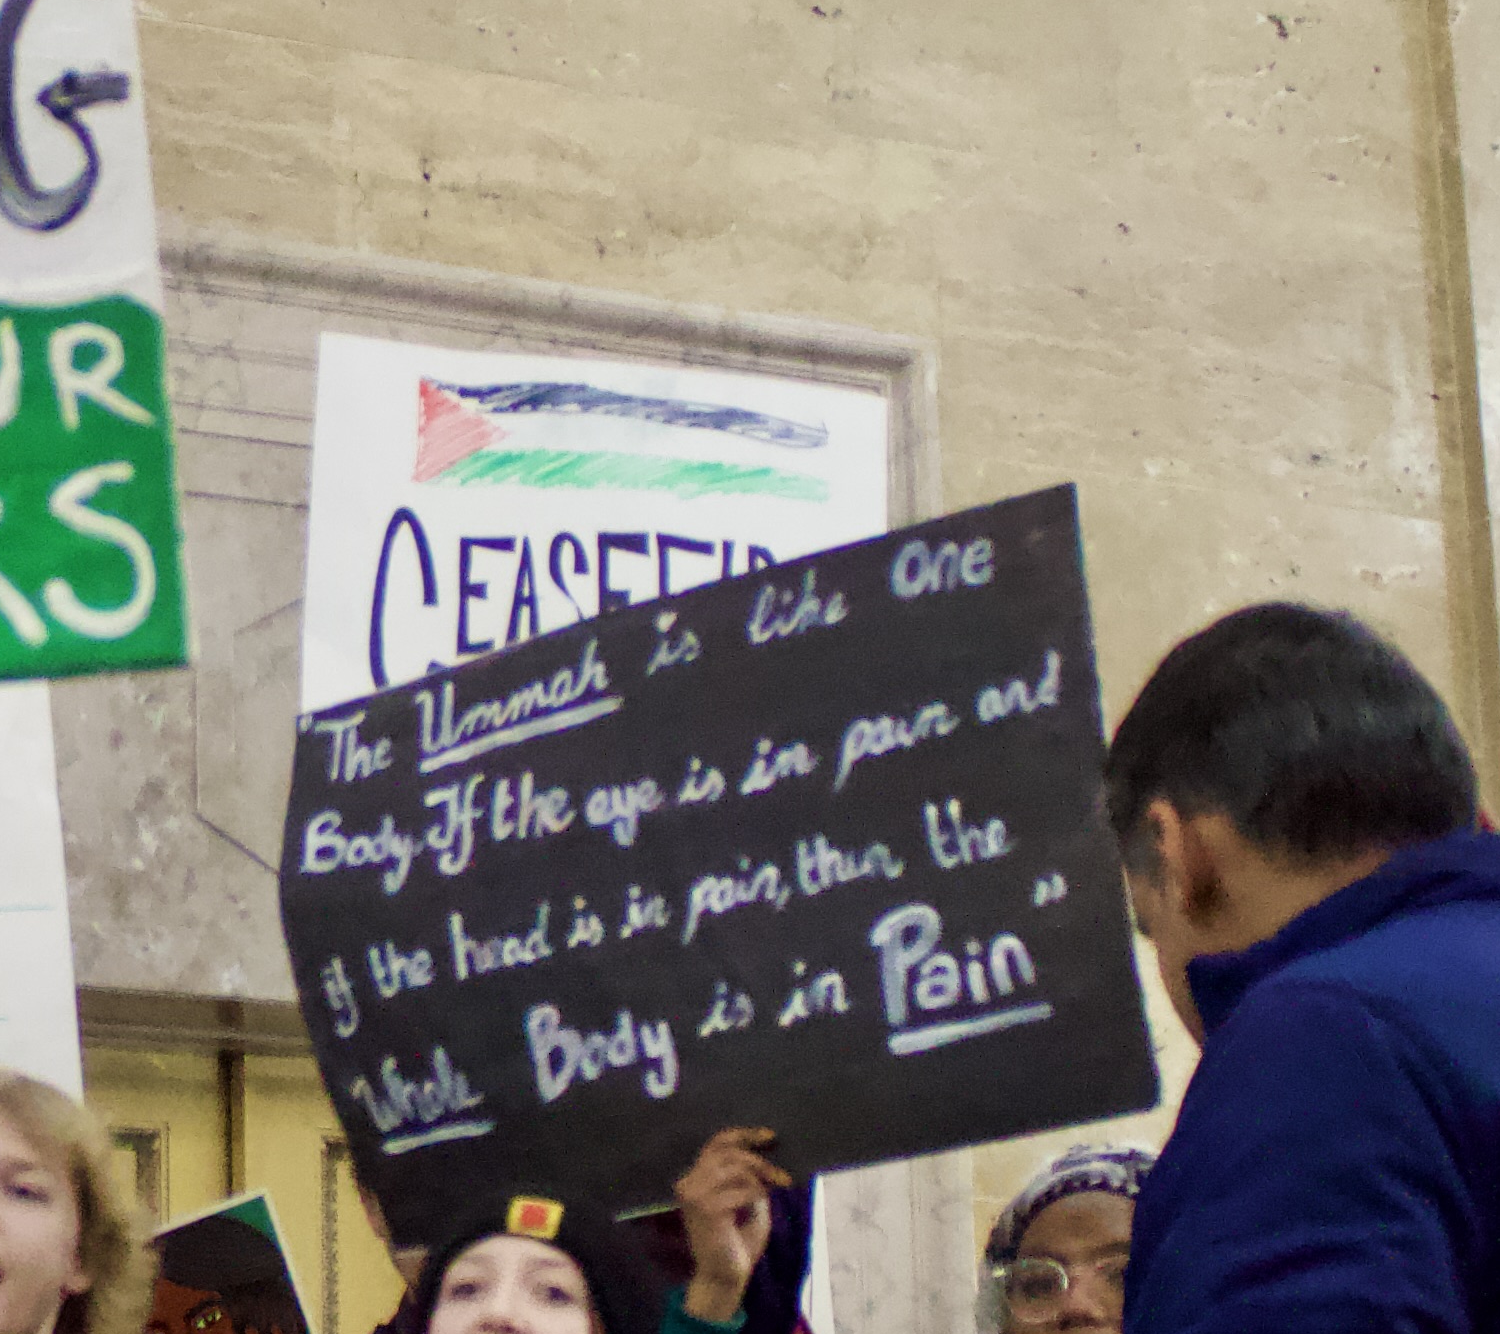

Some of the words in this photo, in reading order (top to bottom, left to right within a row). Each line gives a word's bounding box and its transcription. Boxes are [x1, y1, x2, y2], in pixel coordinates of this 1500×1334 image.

[415, 638, 610, 754] Ummah
[647, 609, 701, 677] is
[746, 567, 850, 646] like
[490, 770, 578, 842] the
[677, 754, 728, 805] is
[737, 736, 824, 797] in
[832, 699, 962, 794] pain
[973, 647, 1064, 725] and
[366, 939, 436, 1000] the
[566, 893, 606, 949] is
[618, 882, 672, 940] in
[922, 795, 1016, 870] the
[523, 1001, 681, 1104] Body
[698, 979, 756, 1038] is
[778, 958, 852, 1028] in
